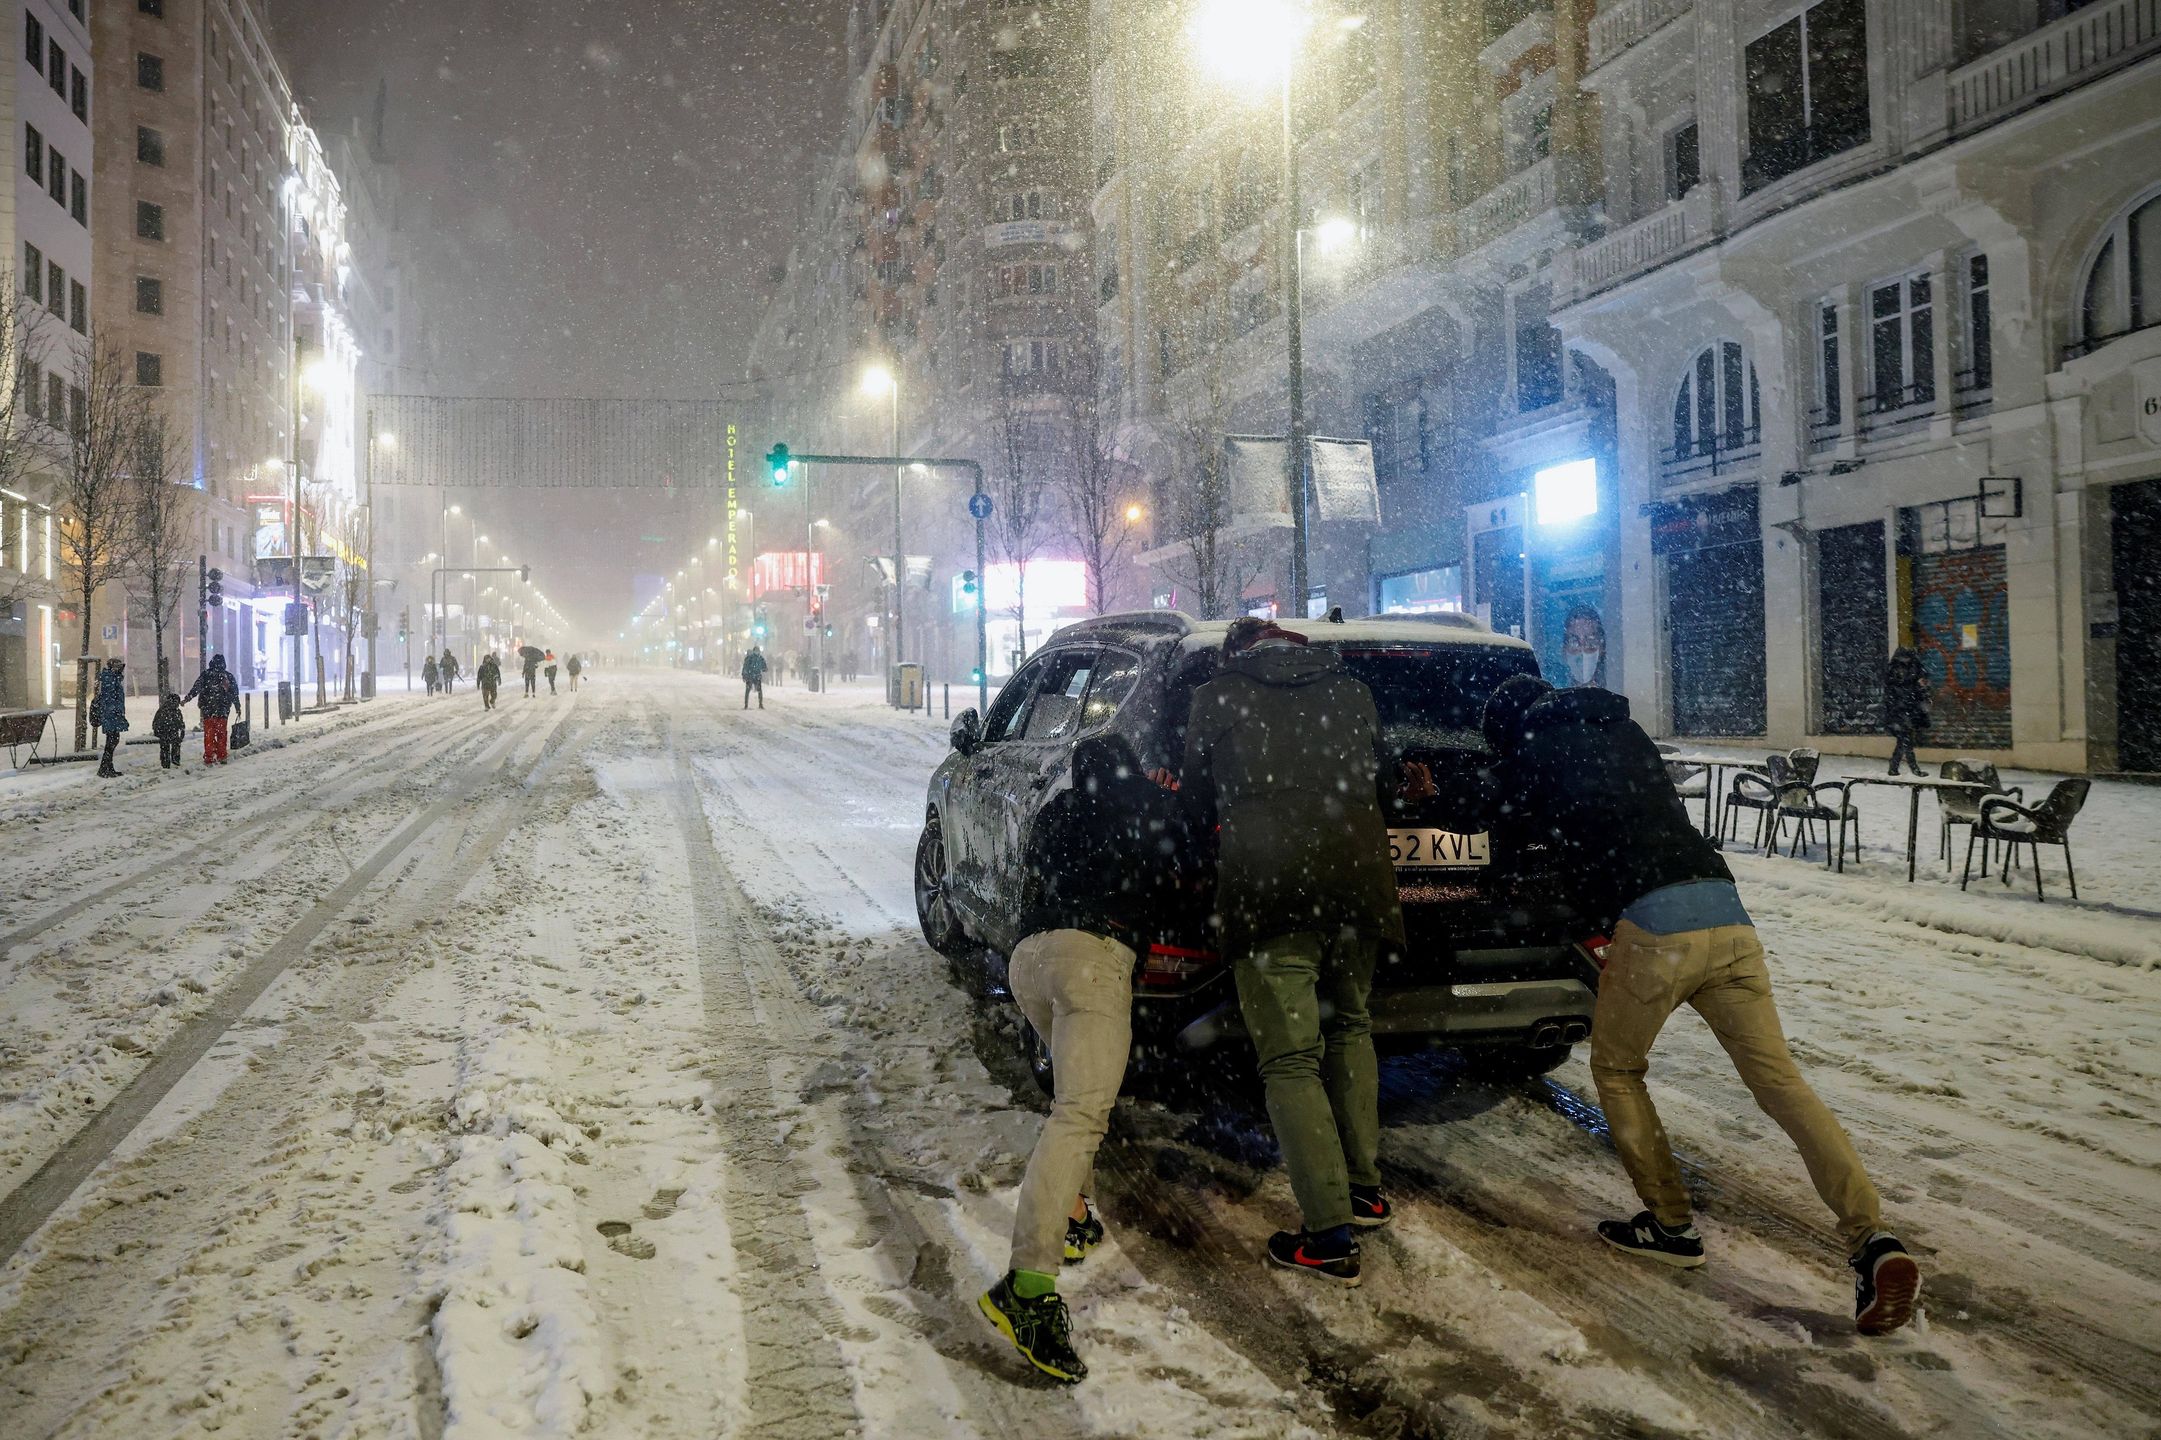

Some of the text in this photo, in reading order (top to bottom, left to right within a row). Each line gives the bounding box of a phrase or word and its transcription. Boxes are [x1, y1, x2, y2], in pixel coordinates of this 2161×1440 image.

[2144, 396, 2161, 416] 6
[727, 424, 738, 590] HOTEL EMPERADOR
[1431, 834, 1483, 861] KVL
[1635, 1226, 1655, 1243] N
